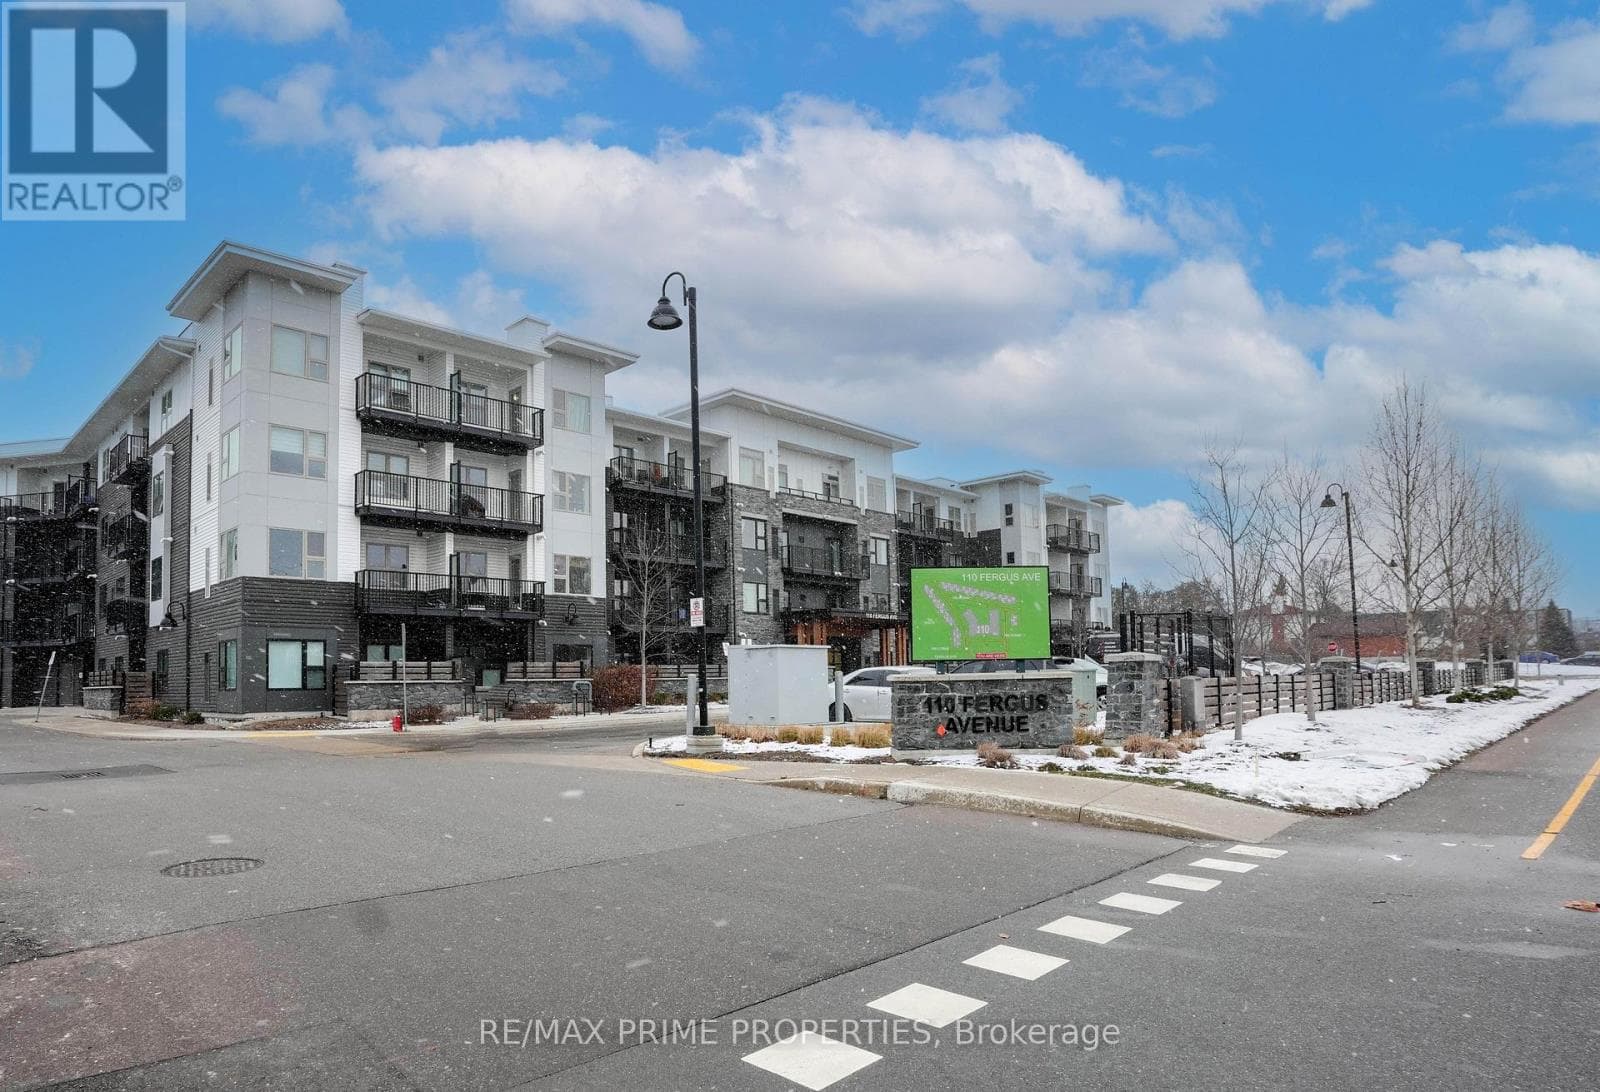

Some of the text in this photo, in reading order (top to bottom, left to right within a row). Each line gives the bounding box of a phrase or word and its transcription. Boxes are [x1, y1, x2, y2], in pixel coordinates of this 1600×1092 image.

[961, 572, 1041, 582] 110 FERGUS AVE
[976, 624, 990, 634] 110
[924, 694, 1049, 714] 110 FERGUS
[946, 715, 1030, 734] AVENUE
